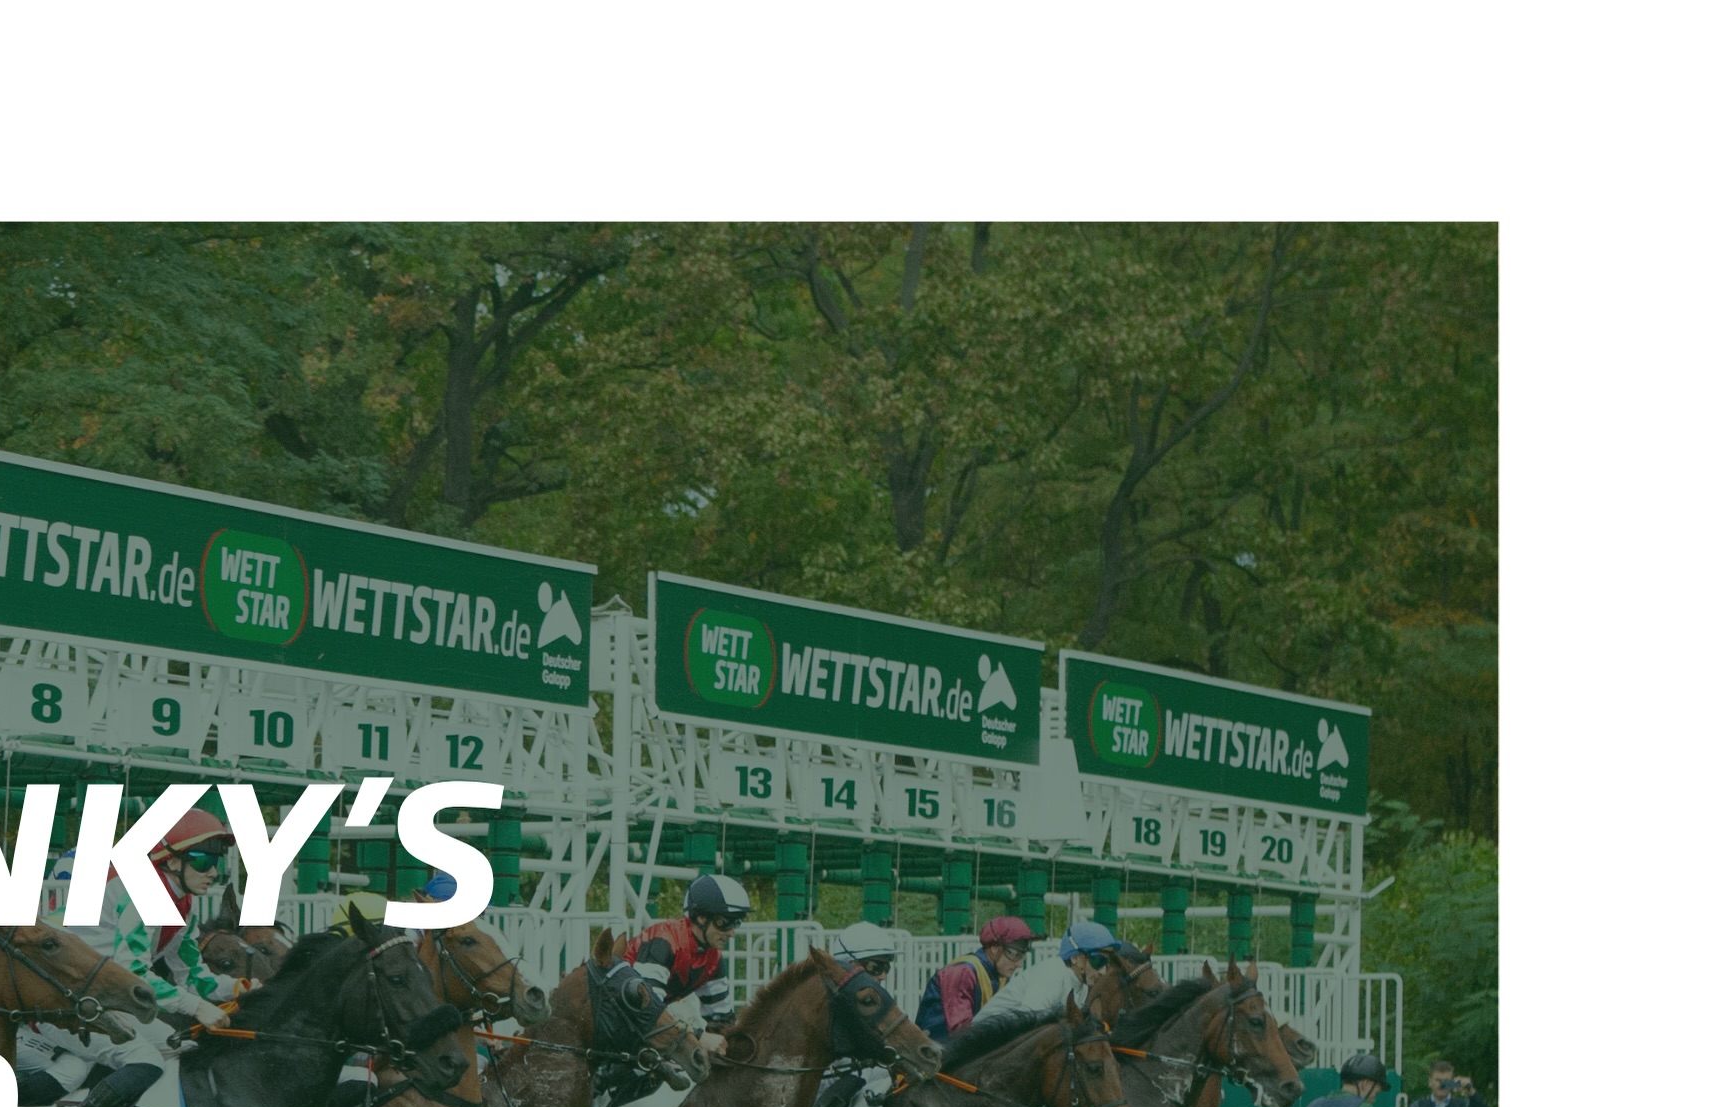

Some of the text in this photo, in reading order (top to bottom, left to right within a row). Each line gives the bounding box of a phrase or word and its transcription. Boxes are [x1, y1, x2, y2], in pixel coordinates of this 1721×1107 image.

[221, 546, 281, 589] WETT
[235, 588, 290, 630] STAR
[313, 568, 531, 660] WETTSTAR.de
[702, 624, 752, 660] WETT
[542, 651, 582, 672] Deutscher
[714, 659, 760, 695] STAR
[541, 669, 571, 690] Galopp
[781, 642, 973, 723] WETTSTAR.de
[31, 682, 63, 724] 8
[152, 697, 181, 737] 9
[1102, 694, 1143, 729] WETT
[249, 709, 294, 749] 10
[981, 730, 1008, 750] Galopp
[982, 715, 1016, 733] Deutscher
[357, 723, 389, 761] 11
[445, 734, 484, 771] 12
[1111, 728, 1149, 757] STAR
[1165, 710, 1313, 779] WETTSTAR.de
[735, 765, 772, 799] 13
[821, 777, 858, 811] 14
[904, 787, 940, 820] 15
[983, 798, 1016, 828] 16
[1132, 816, 1162, 846] 18
[1199, 829, 1227, 857] 19
[1261, 835, 1293, 864] 20
